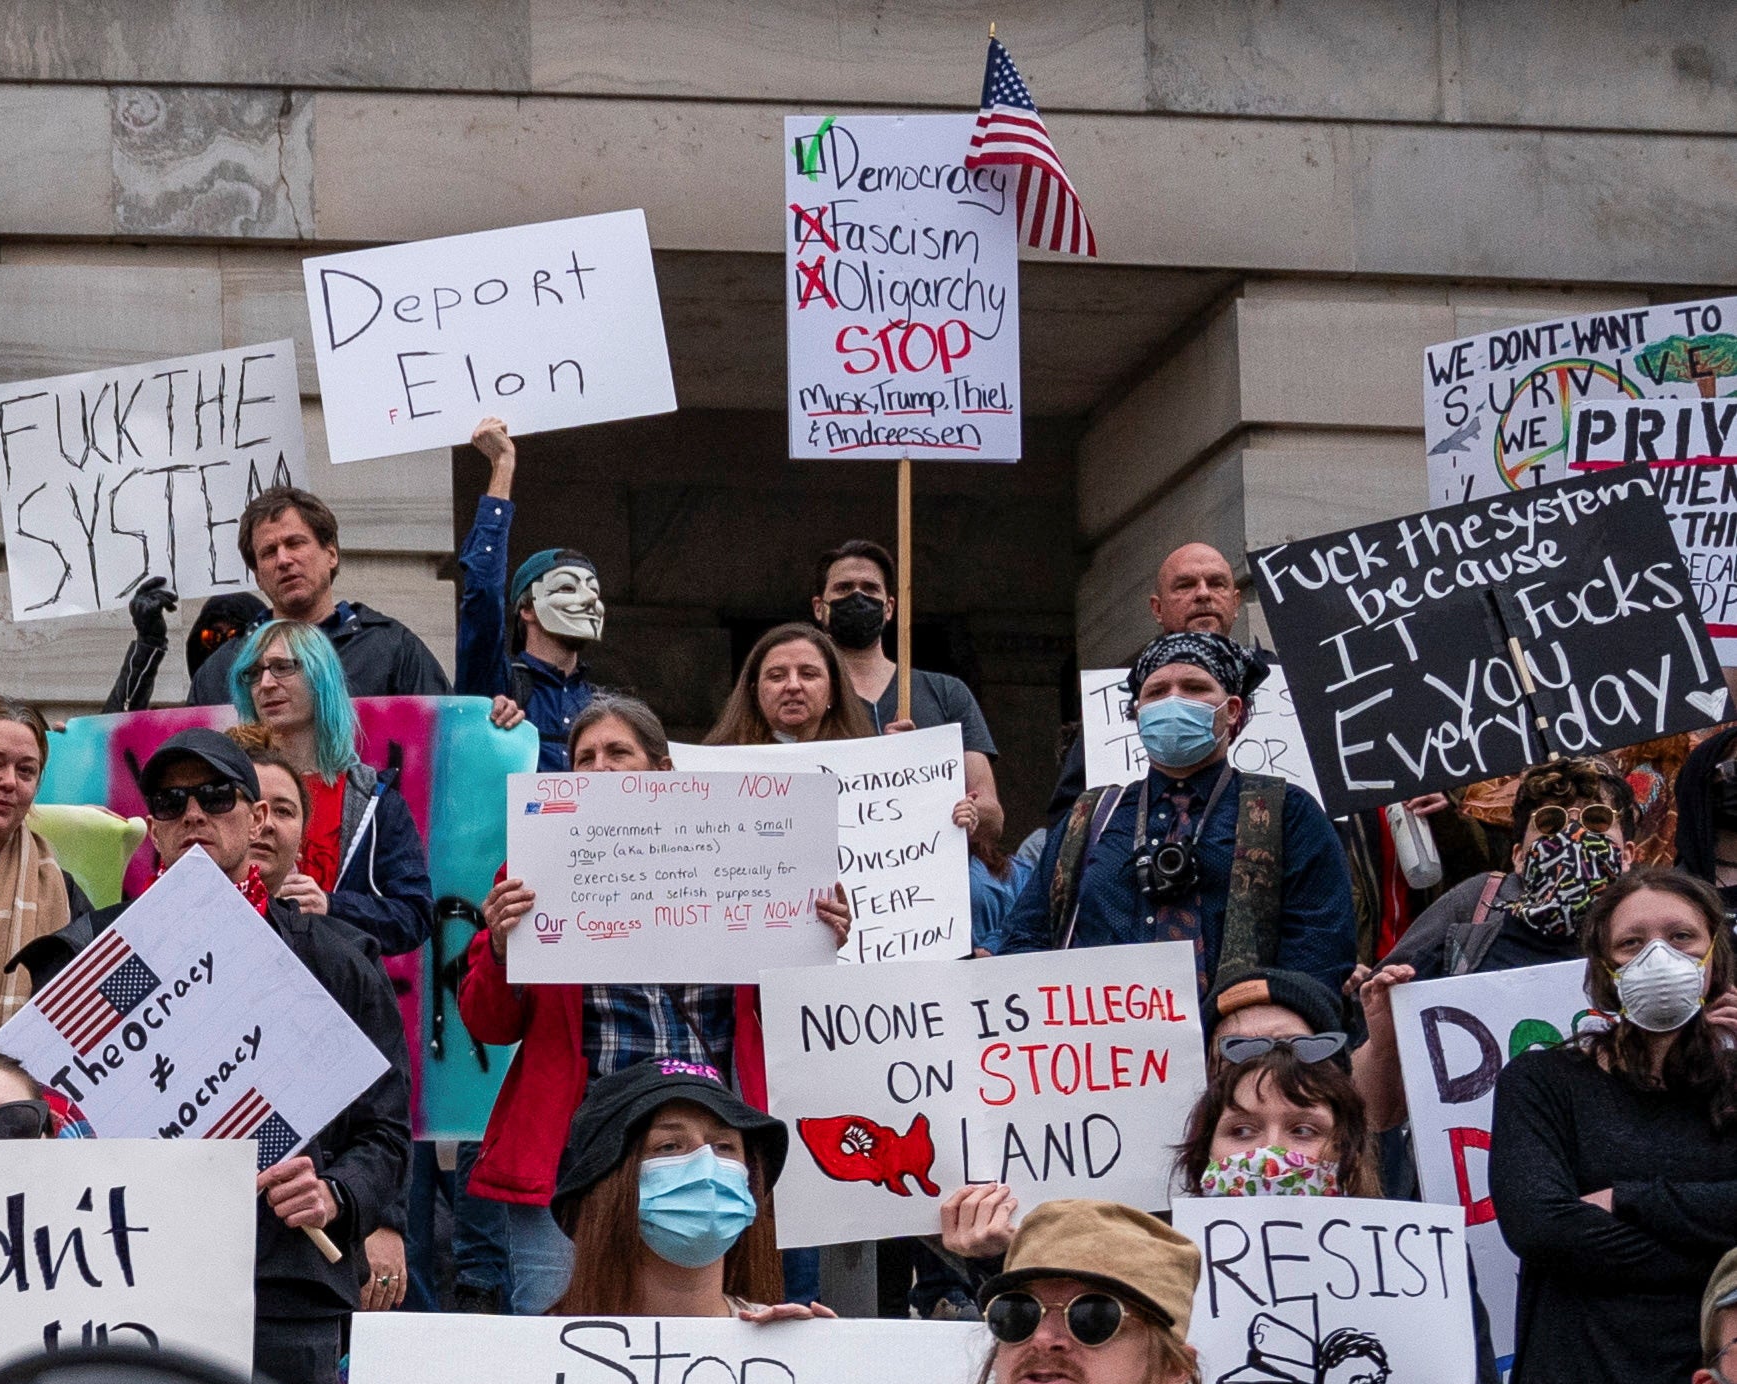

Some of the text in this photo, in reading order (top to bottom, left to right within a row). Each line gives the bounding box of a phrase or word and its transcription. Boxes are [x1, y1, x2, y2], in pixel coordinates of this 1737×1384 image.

[828, 125, 1007, 216] Democracy
[829, 199, 979, 264] Fascism
[835, 259, 1006, 340] Oligarchy
[835, 319, 972, 375] STOP
[1428, 341, 1474, 387] WE
[1571, 311, 1650, 355] WANT
[1674, 305, 1721, 337] TO
[153, 354, 275, 456] THE
[397, 351, 584, 420] Elon
[1346, 540, 1567, 626] because
[534, 774, 792, 803] STOP Oligarchy NOW
[838, 799, 903, 828] IES
[570, 818, 793, 842] a government in which a small
[838, 831, 940, 874] DIVISION
[567, 848, 606, 868] group
[574, 862, 797, 885] exercises control especially for
[534, 912, 567, 932] Our
[577, 911, 641, 936] Congress
[655, 904, 711, 927] MUST
[724, 904, 752, 921] ACT
[571, 887, 771, 907] corrupt and selfish purposes
[851, 886, 934, 919] FEAR
[858, 917, 954, 963] FICTION
[971, 994, 1030, 1039] IS
[1038, 984, 1186, 1026] ILLEGAL
[887, 1042, 1169, 1106] ON STOLEN
[961, 1113, 1121, 1185] LAND
[1204, 1219, 1455, 1318] RESIST
